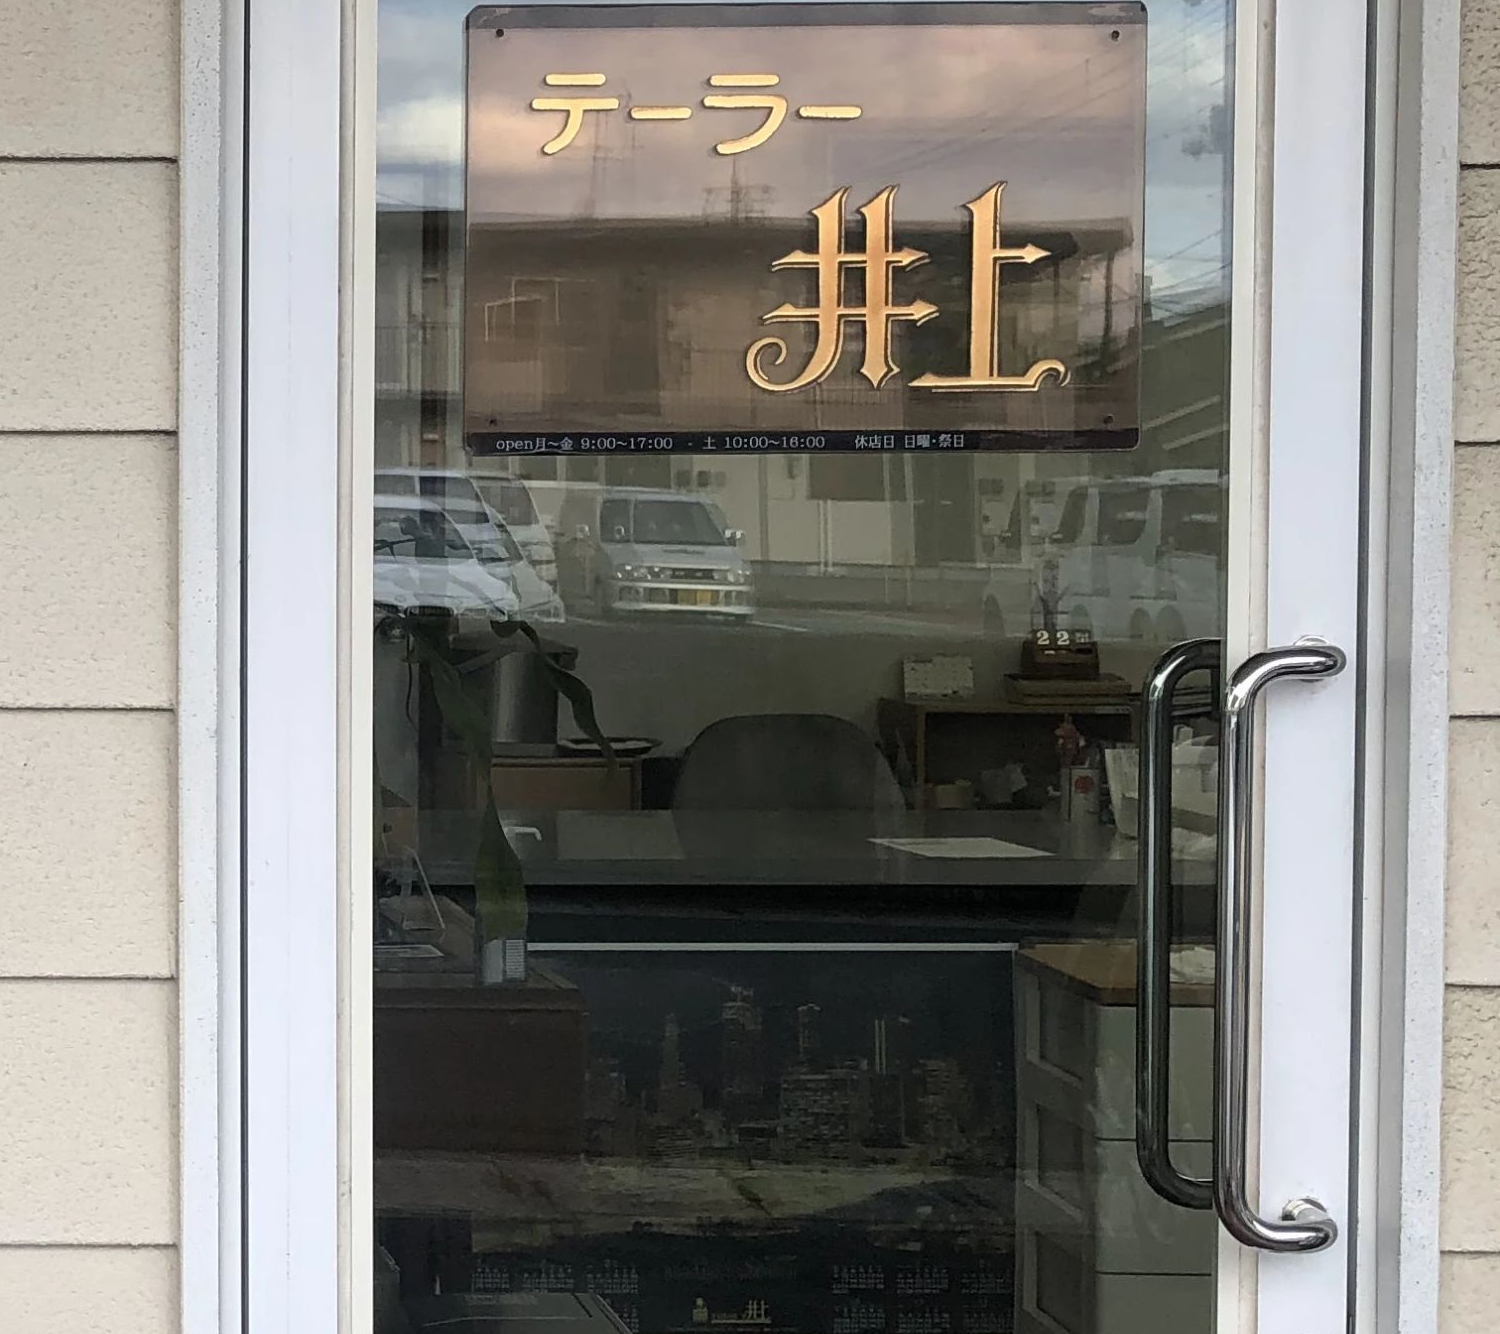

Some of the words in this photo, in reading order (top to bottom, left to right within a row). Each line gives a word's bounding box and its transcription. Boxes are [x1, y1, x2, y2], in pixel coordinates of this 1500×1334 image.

[531, 72, 864, 156] テーラー
[744, 180, 1071, 394] 井上
[854, 434, 895, 449] 休店日
